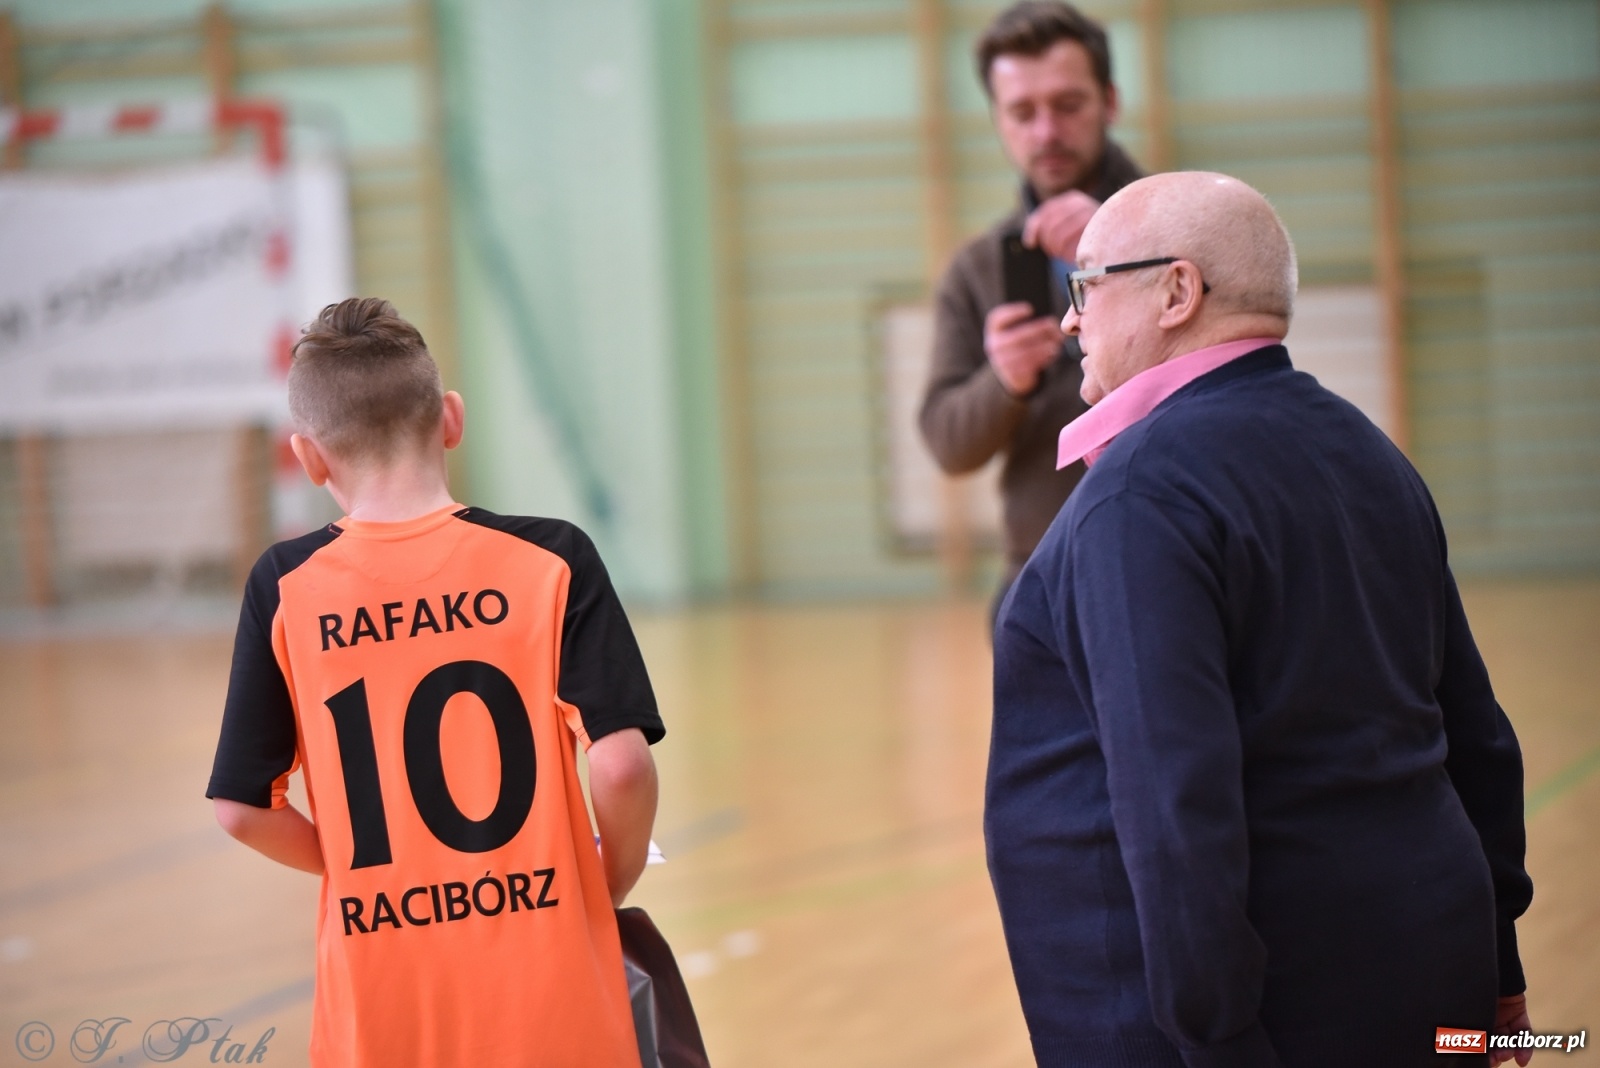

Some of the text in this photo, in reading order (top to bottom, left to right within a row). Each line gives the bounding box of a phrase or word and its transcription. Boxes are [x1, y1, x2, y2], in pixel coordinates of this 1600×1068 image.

[318, 588, 509, 651] RAFAKO
[323, 659, 537, 870] 10
[339, 867, 560, 936] RACIBÓRZ
